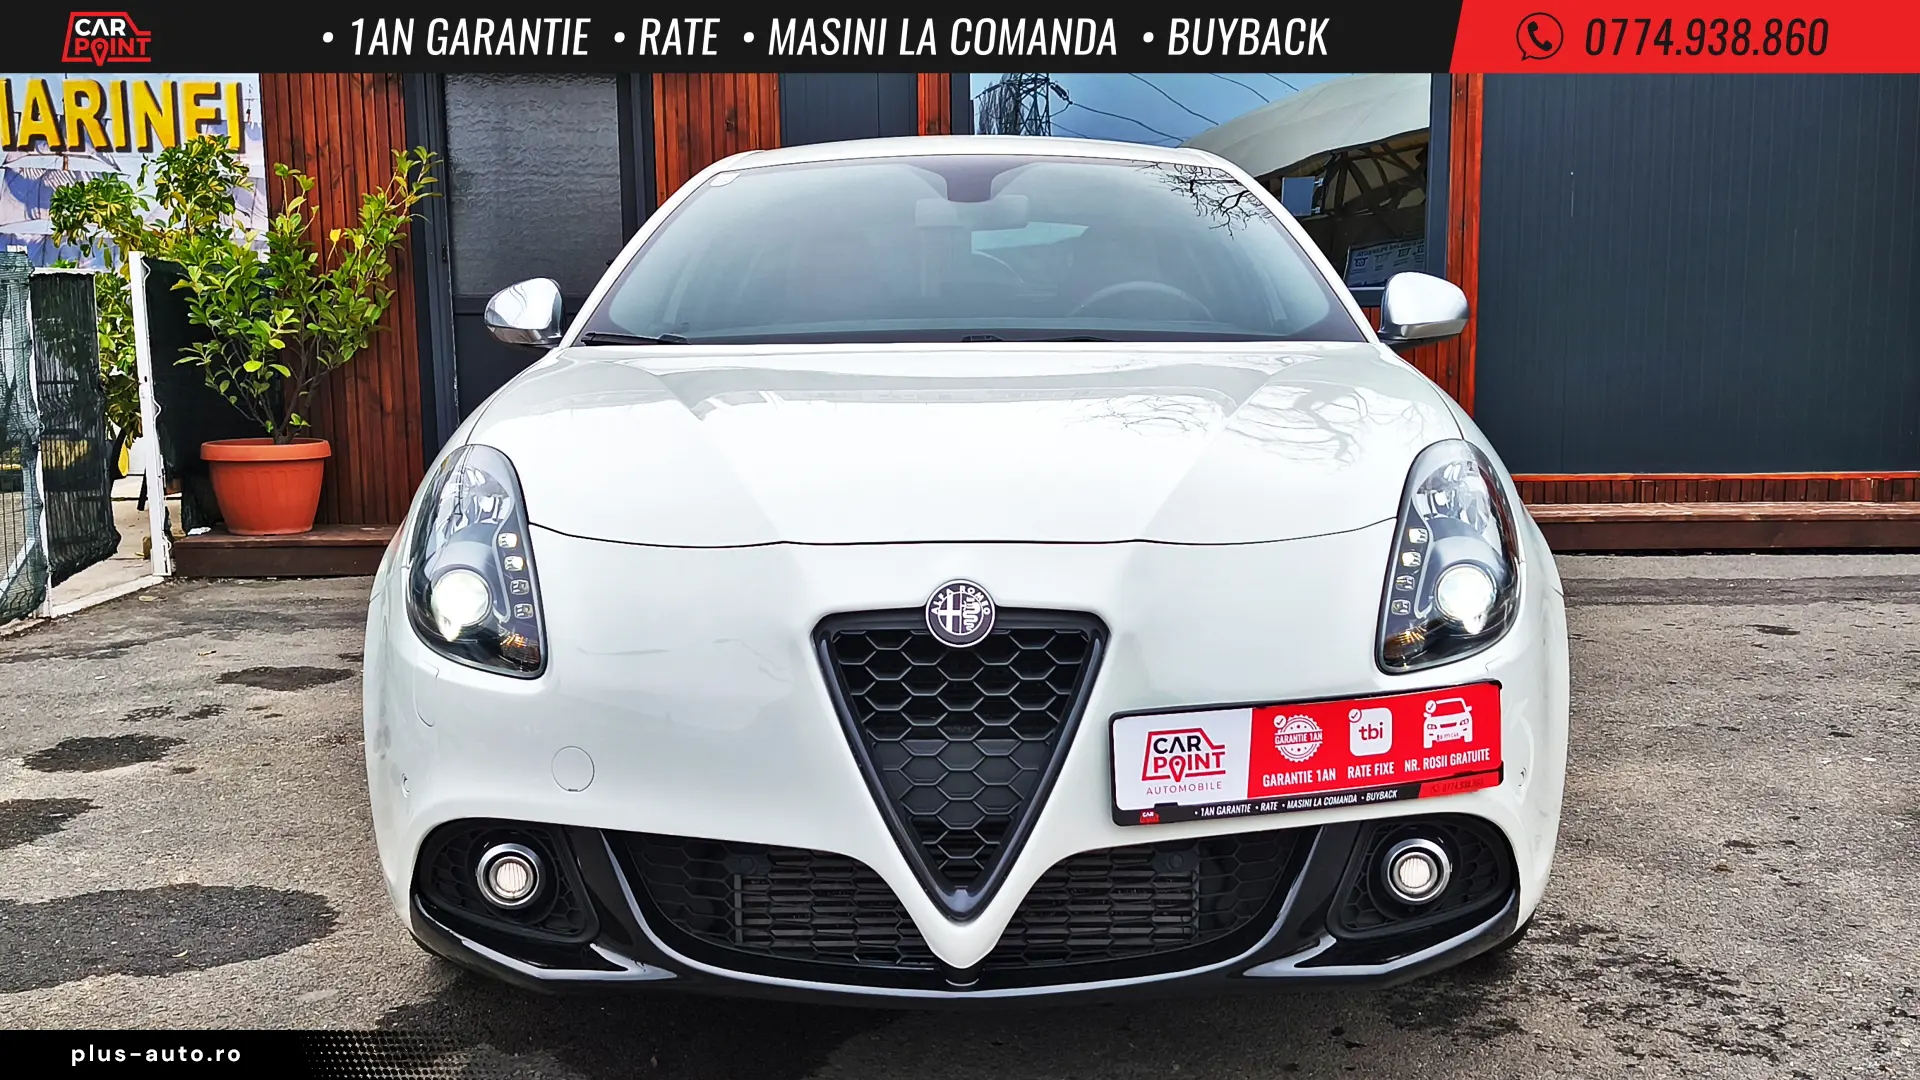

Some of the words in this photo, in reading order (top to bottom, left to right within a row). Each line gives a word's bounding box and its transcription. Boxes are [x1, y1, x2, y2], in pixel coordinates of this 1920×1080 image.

[0, 78, 242, 153] ARINEI
[931, 588, 954, 614] ALFA
[960, 585, 990, 615] ROMEO
[1274, 733, 1308, 745] GARANTIE
[1309, 731, 1323, 742] 1AN
[1358, 722, 1384, 741] tbi
[1153, 735, 1202, 754] CAR
[1153, 751, 1226, 782] POINT
[1347, 764, 1372, 779] RATE
[1374, 761, 1395, 776] FIXE
[1404, 759, 1421, 773] NR.
[1423, 755, 1448, 770] ROSII
[1450, 748, 1490, 766] GRATUITE
[1262, 770, 1313, 787] GARANTIE
[1316, 768, 1337, 782] 1AN
[1146, 781, 1222, 795] AUTOMOBILE
[1201, 808, 1215, 817] 1AN
[1216, 804, 1252, 816] GARANTIE
[1260, 801, 1278, 812] RATE
[1286, 799, 1313, 809] MASINI
[1313, 797, 1323, 807] LA
[1323, 795, 1358, 806] COMANDA
[1365, 790, 1398, 801] BUYBACK
